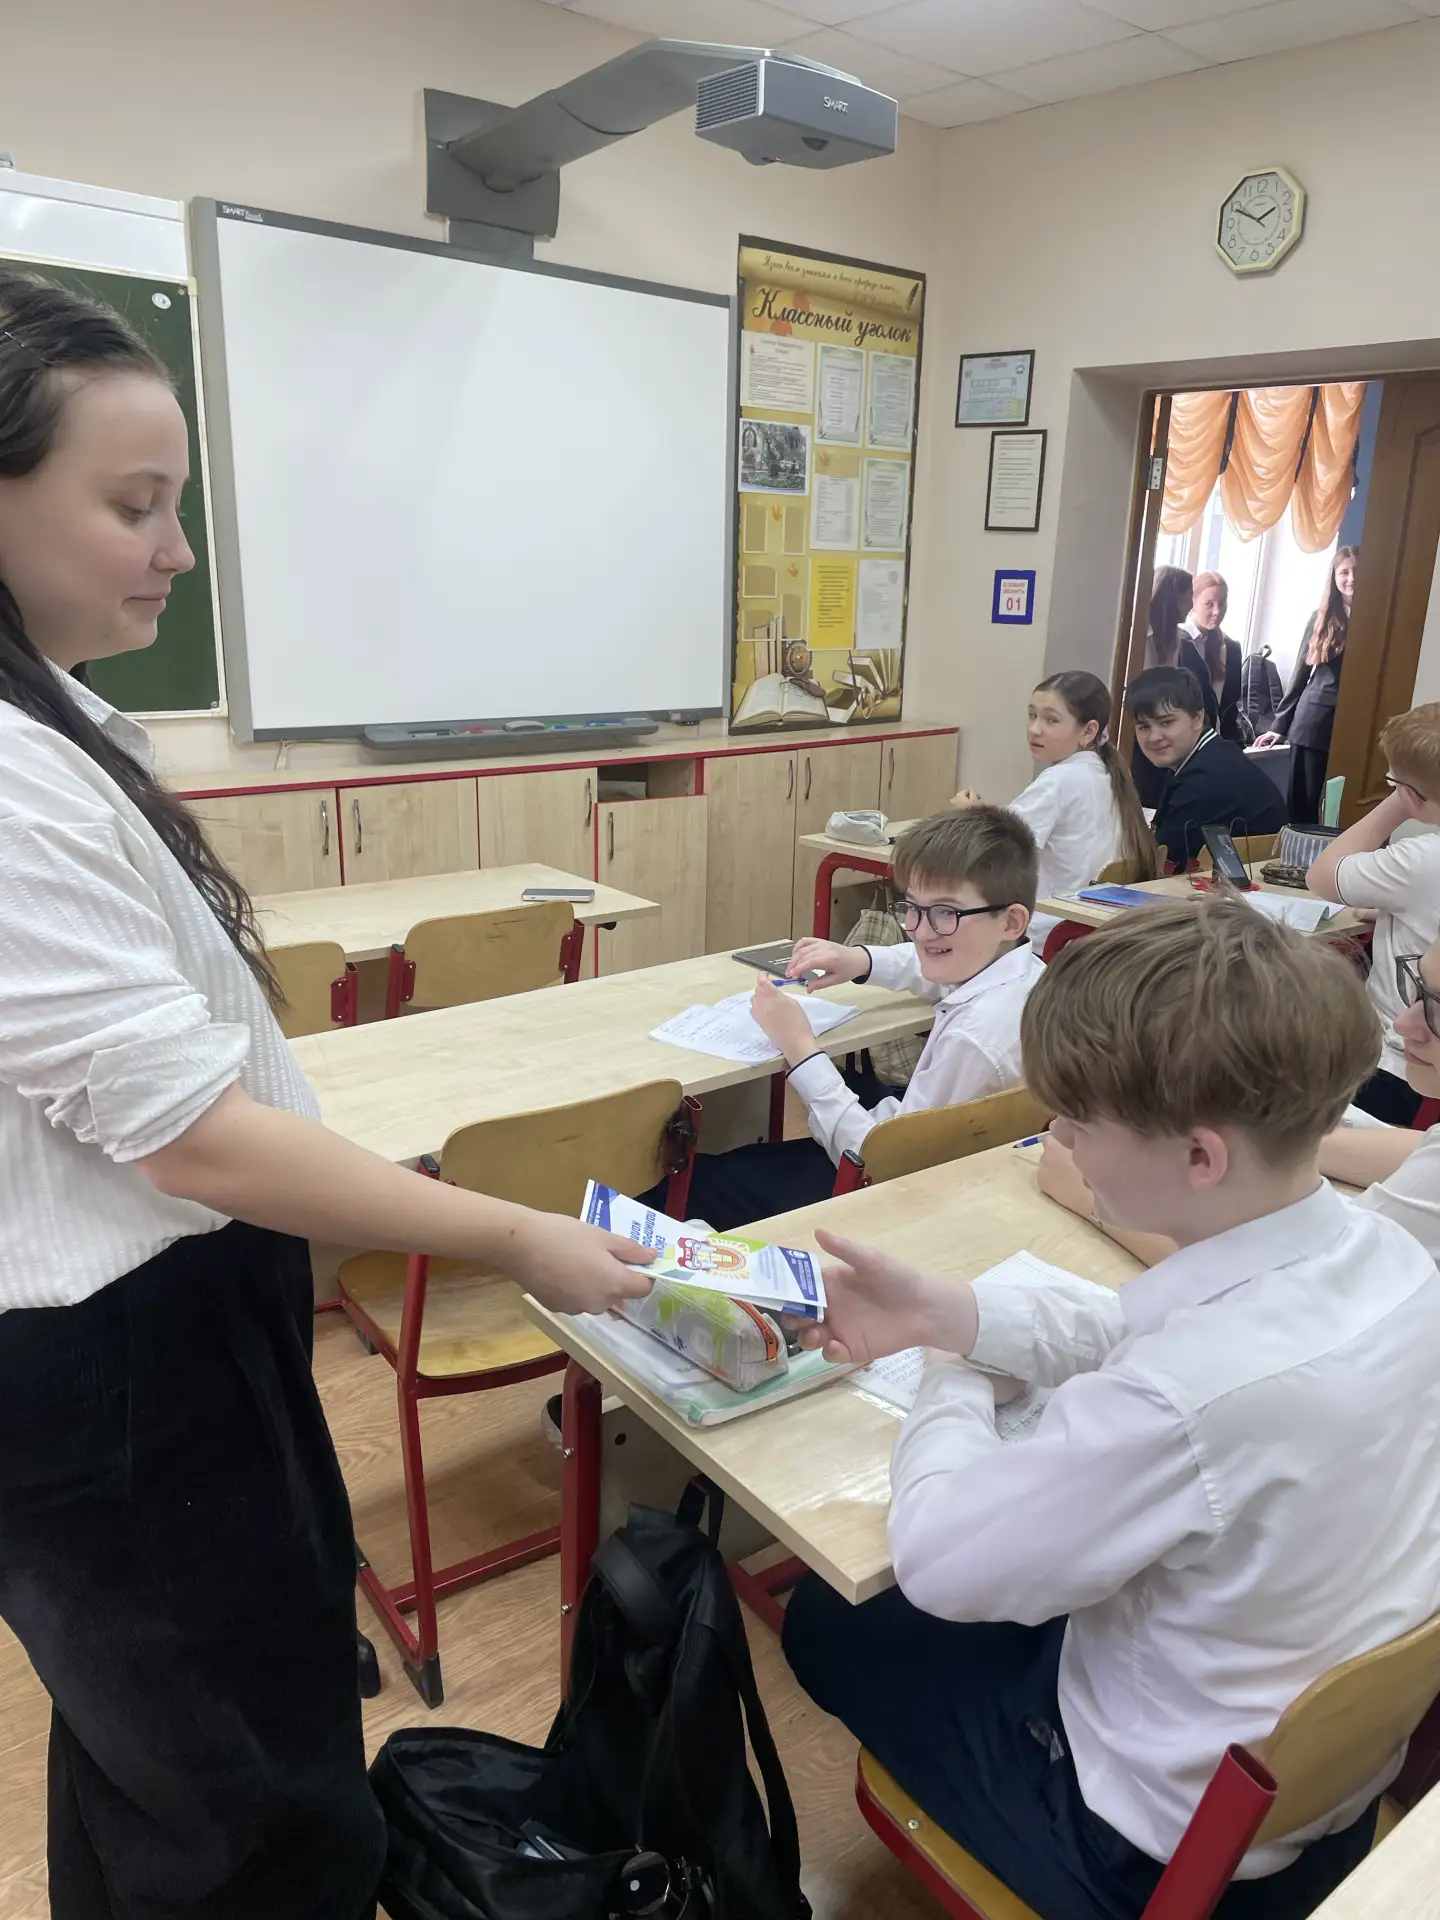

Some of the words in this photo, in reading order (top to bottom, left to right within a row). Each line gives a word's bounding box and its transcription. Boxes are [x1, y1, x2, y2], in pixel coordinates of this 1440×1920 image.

[1244, 185, 1252, 198] 11
[1257, 179, 1269, 193] 12
[1282, 190, 1291, 205] 2
[1282, 208, 1293, 223] 3
[1226, 218, 1235, 232] 9
[1228, 234, 1236, 248] 8
[1276, 228, 1286, 241] 4
[1237, 247, 1246, 260] 7
[1250, 249, 1259, 261] 6
[1265, 243, 1275, 255] 5
[752, 287, 853, 333] Классный
[854, 319, 912, 347] уголок
[1006, 597, 1021, 611] 01
